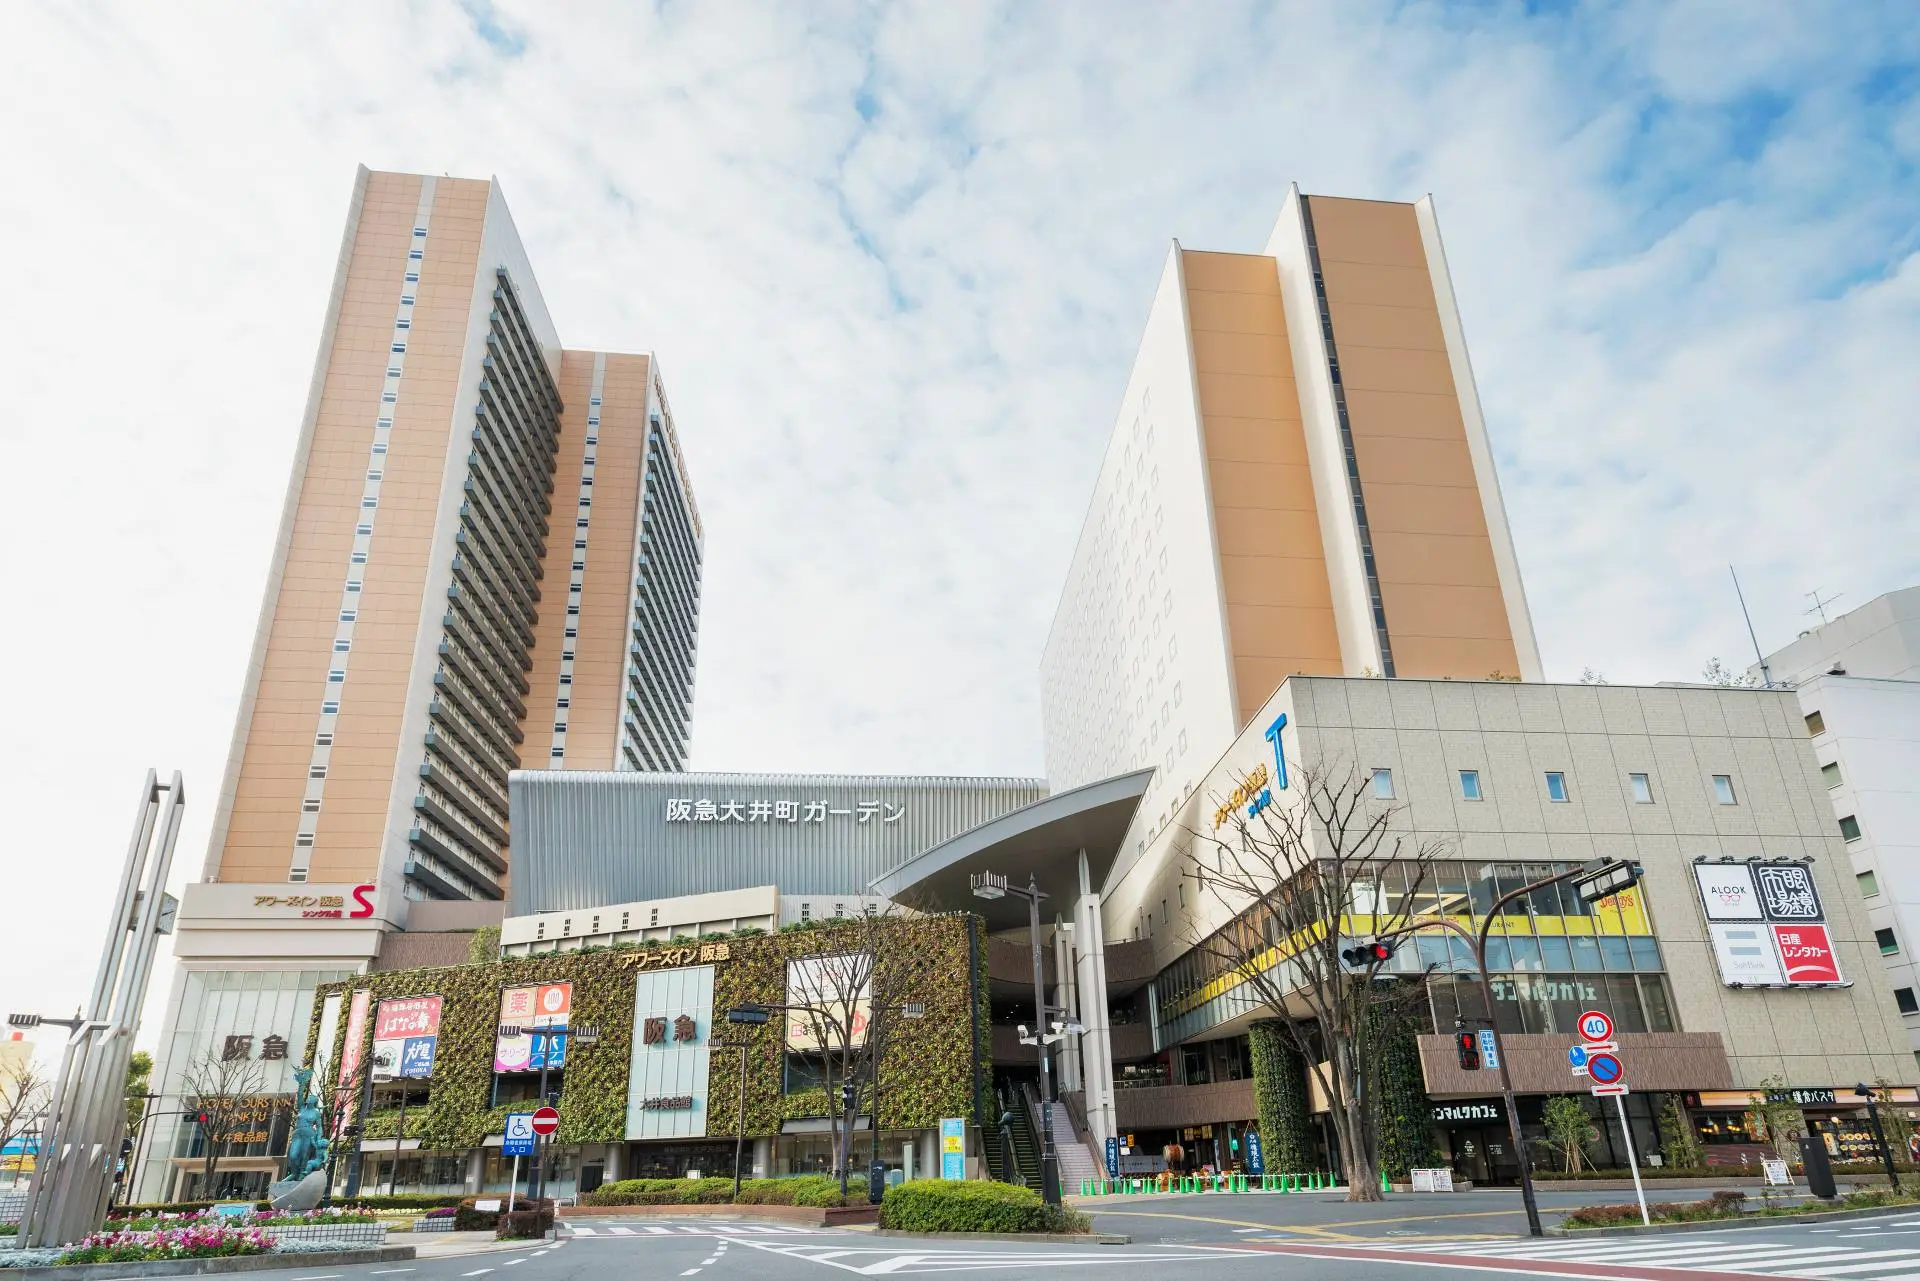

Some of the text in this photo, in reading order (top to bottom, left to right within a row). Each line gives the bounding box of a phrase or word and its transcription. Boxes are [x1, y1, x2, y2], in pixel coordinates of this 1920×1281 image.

[1264, 712, 1288, 790] T
[665, 798, 906, 823] 阪急大井町ガーデン
[1711, 886, 1747, 894] ALOOK
[253, 895, 344, 907] アワーズイン 阪急
[349, 884, 376, 919] S
[1780, 933, 1802, 945] 日産
[622, 943, 730, 970] アワーズイン 阪急
[1783, 946, 1828, 958] レンタカー
[510, 991, 528, 1013] 薬
[643, 1014, 697, 1045] 阪急
[1586, 1020, 1605, 1034] 40
[222, 1034, 289, 1061] 阪急
[272, 1098, 292, 1108] INN
[1792, 1088, 1834, 1103] 鎌倉パスタ
[640, 1096, 692, 1111] 大井食品館
